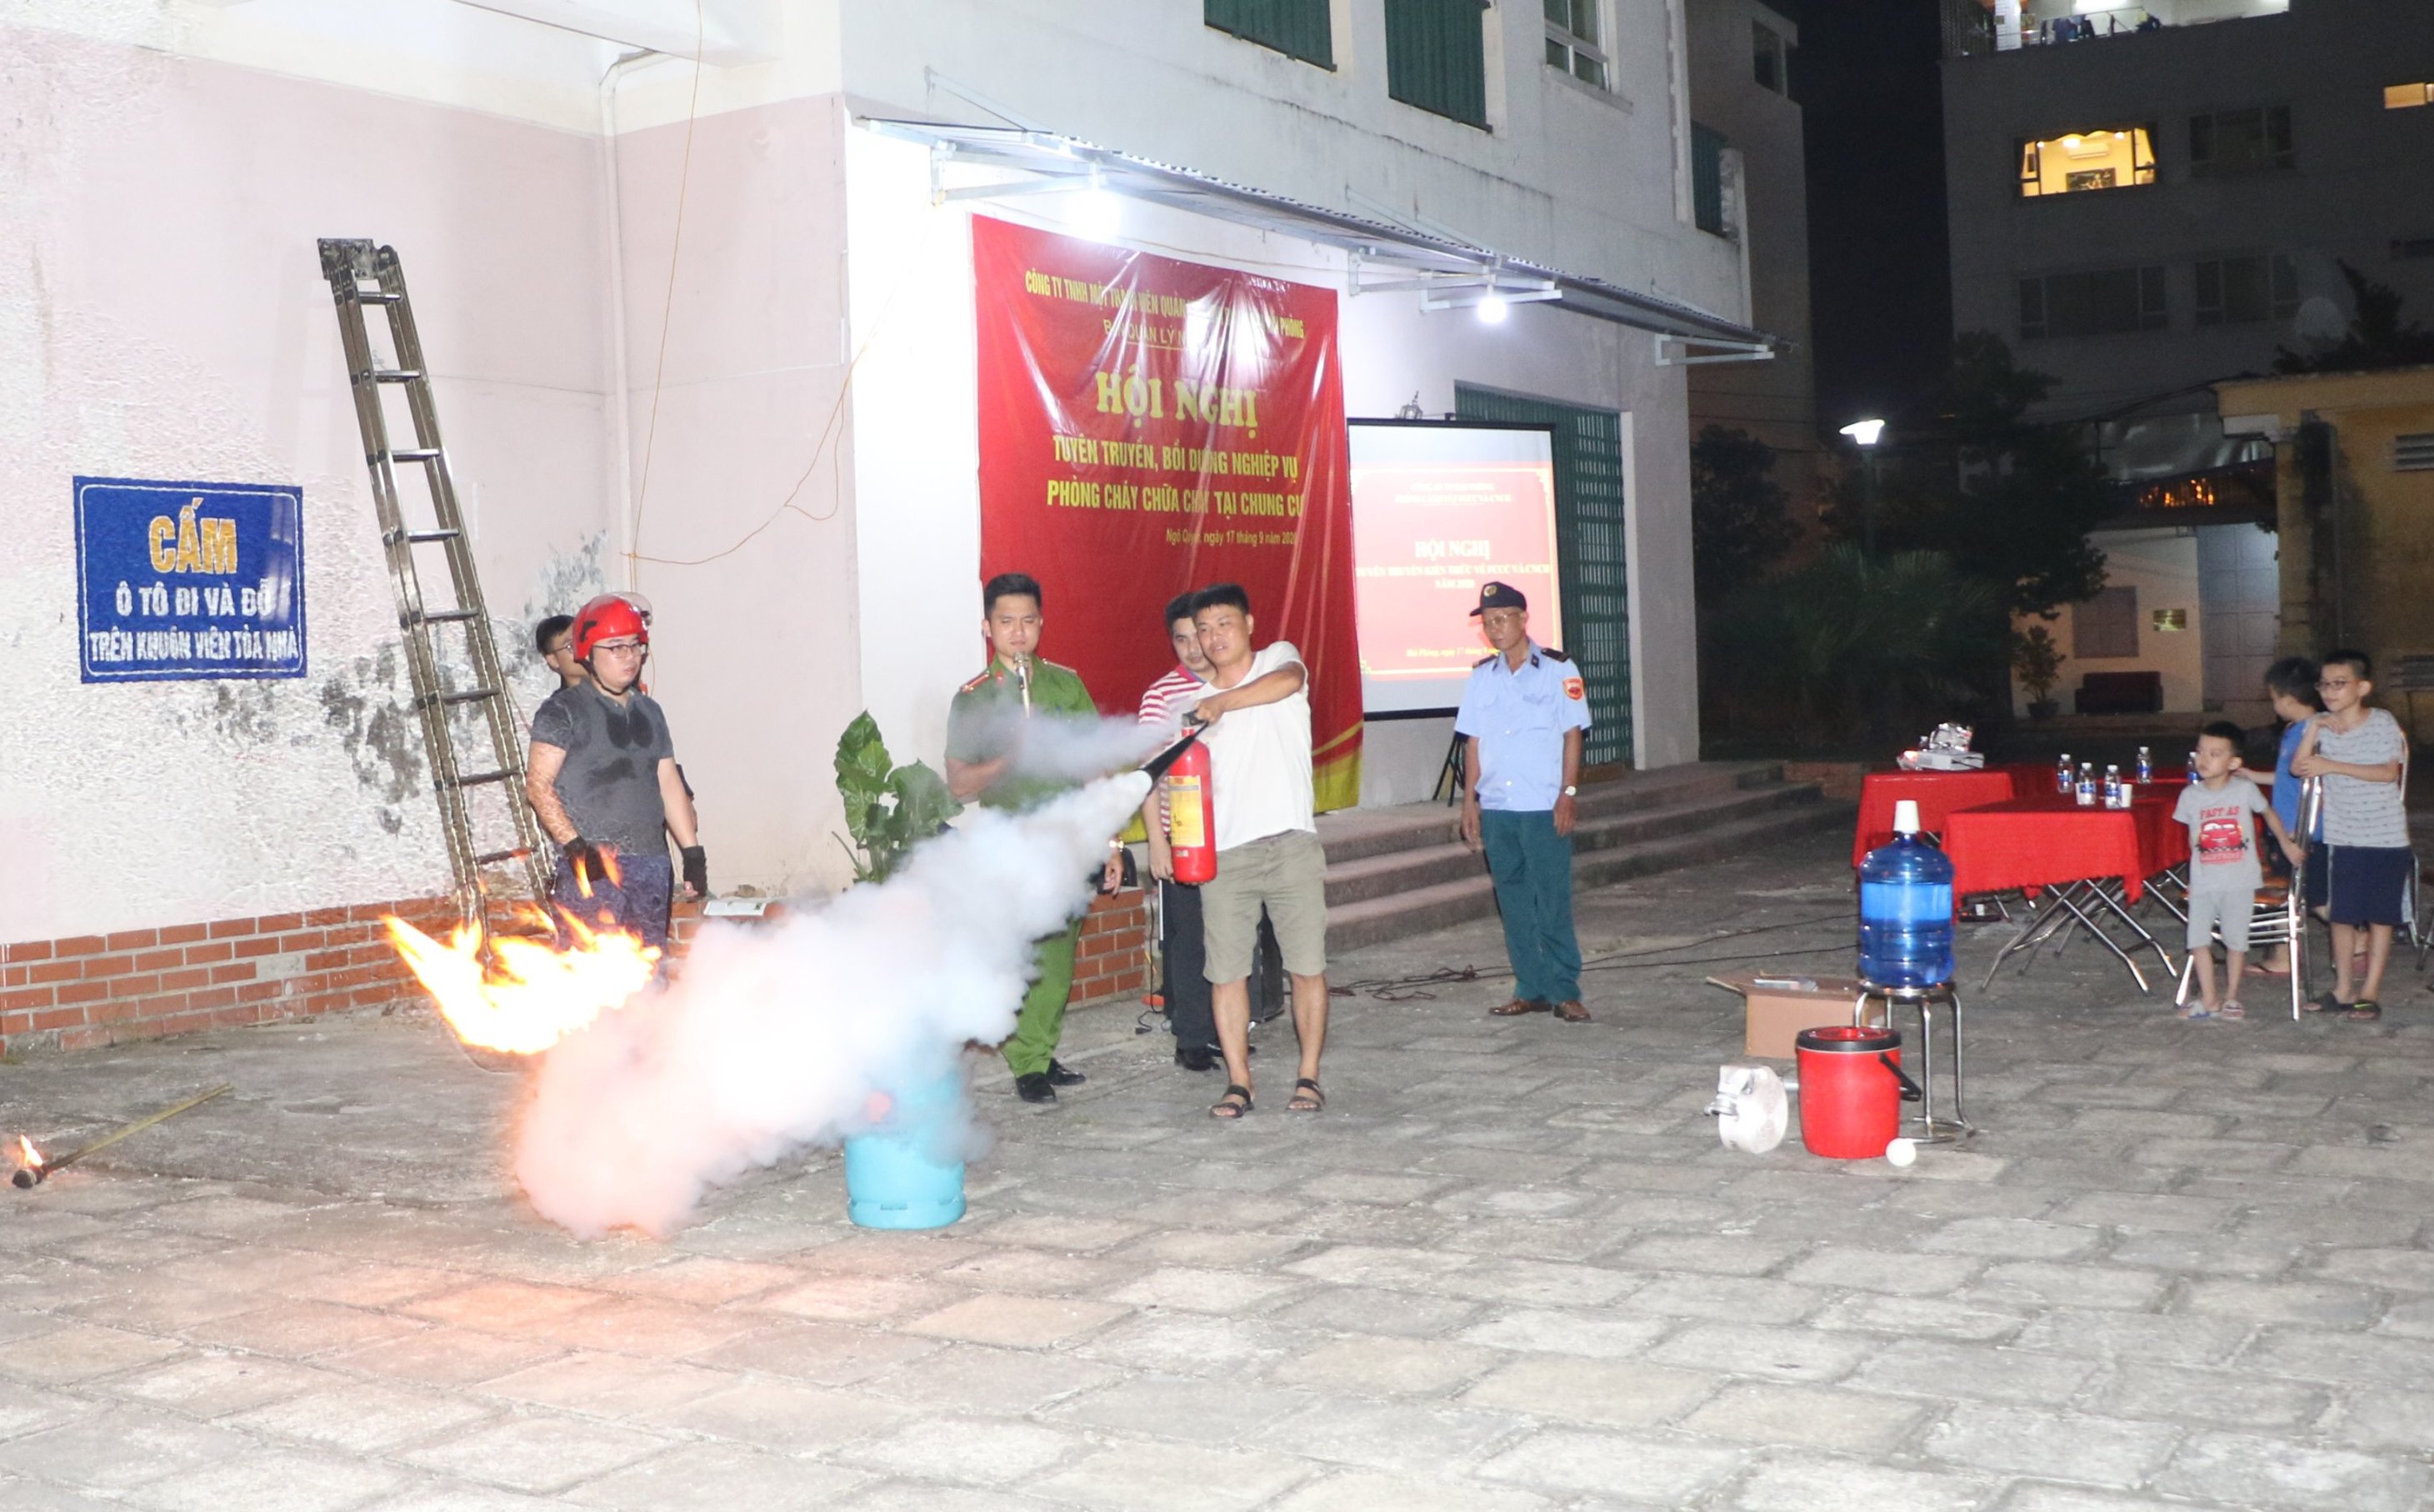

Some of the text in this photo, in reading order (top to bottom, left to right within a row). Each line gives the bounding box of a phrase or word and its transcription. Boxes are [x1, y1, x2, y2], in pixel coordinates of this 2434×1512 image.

[1025, 267, 1051, 297] CÔNG
[1051, 276, 1062, 298] TY
[1063, 278, 1088, 302] TNHH
[1108, 285, 1137, 312] THÀH
[1095, 363, 1258, 439] HỘI NGHỊ
[1052, 433, 1099, 465] TUYÊN
[1232, 450, 1279, 482] NGHIỆP
[1282, 456, 1297, 483] VỤ
[1047, 475, 1100, 508] PHÒNG
[1104, 480, 1138, 511] CHÁY
[1142, 483, 1180, 512] CHỮA
[1214, 491, 1237, 520] TẠI
[1241, 492, 1284, 516] CHUNG
[149, 497, 238, 575] CẤM
[1415, 538, 1491, 561] HỘI NGHỊ
[116, 578, 272, 616] Ô TÔ ĐI VÀ ĐỖ
[89, 626, 133, 662] TRÊN
[136, 625, 192, 661] KHUÔN
[194, 626, 232, 661] VIÊN
[265, 626, 298, 661] NHÀ
